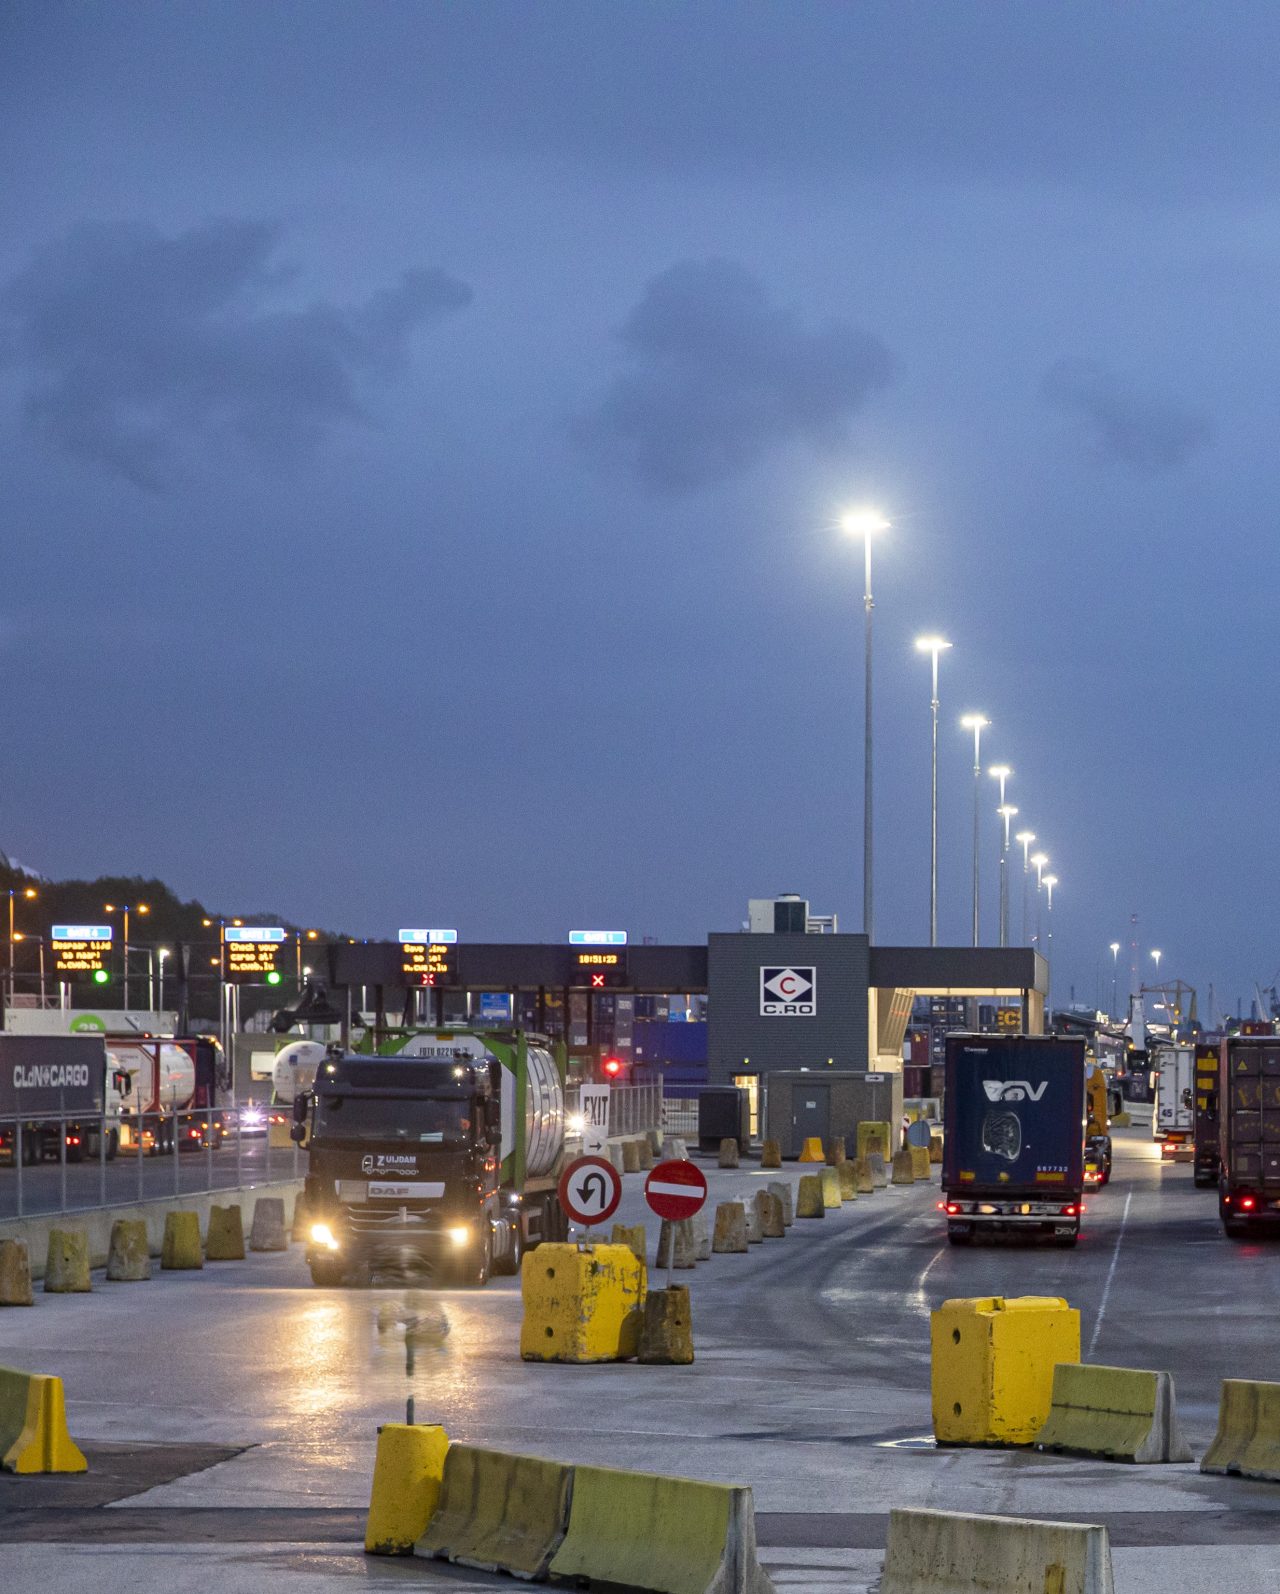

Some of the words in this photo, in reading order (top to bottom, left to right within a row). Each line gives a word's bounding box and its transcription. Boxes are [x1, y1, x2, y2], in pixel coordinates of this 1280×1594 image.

[763, 1004, 813, 1014] C.RO
[50, 1064, 89, 1087] CARGO
[584, 1096, 608, 1126] EXIT
[370, 1187, 409, 1195] DAF
[1055, 1227, 1077, 1235] DSV
